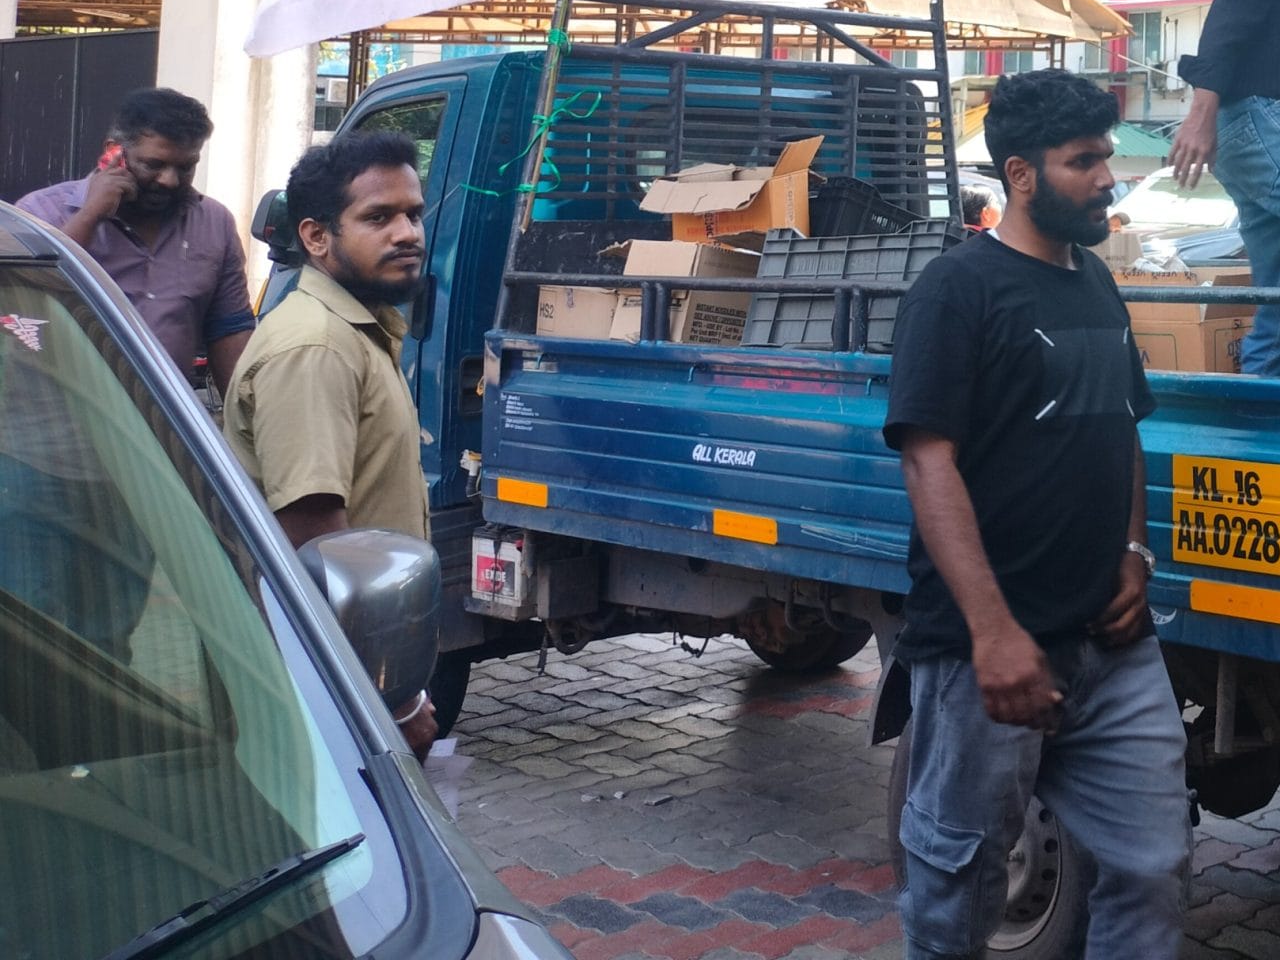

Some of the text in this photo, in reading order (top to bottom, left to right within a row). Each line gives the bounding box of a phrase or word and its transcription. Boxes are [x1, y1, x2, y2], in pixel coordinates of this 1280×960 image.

[539, 303, 554, 319] HS2
[692, 444, 757, 468] ALL KERALA
[1177, 510, 1280, 564] AA.0228
